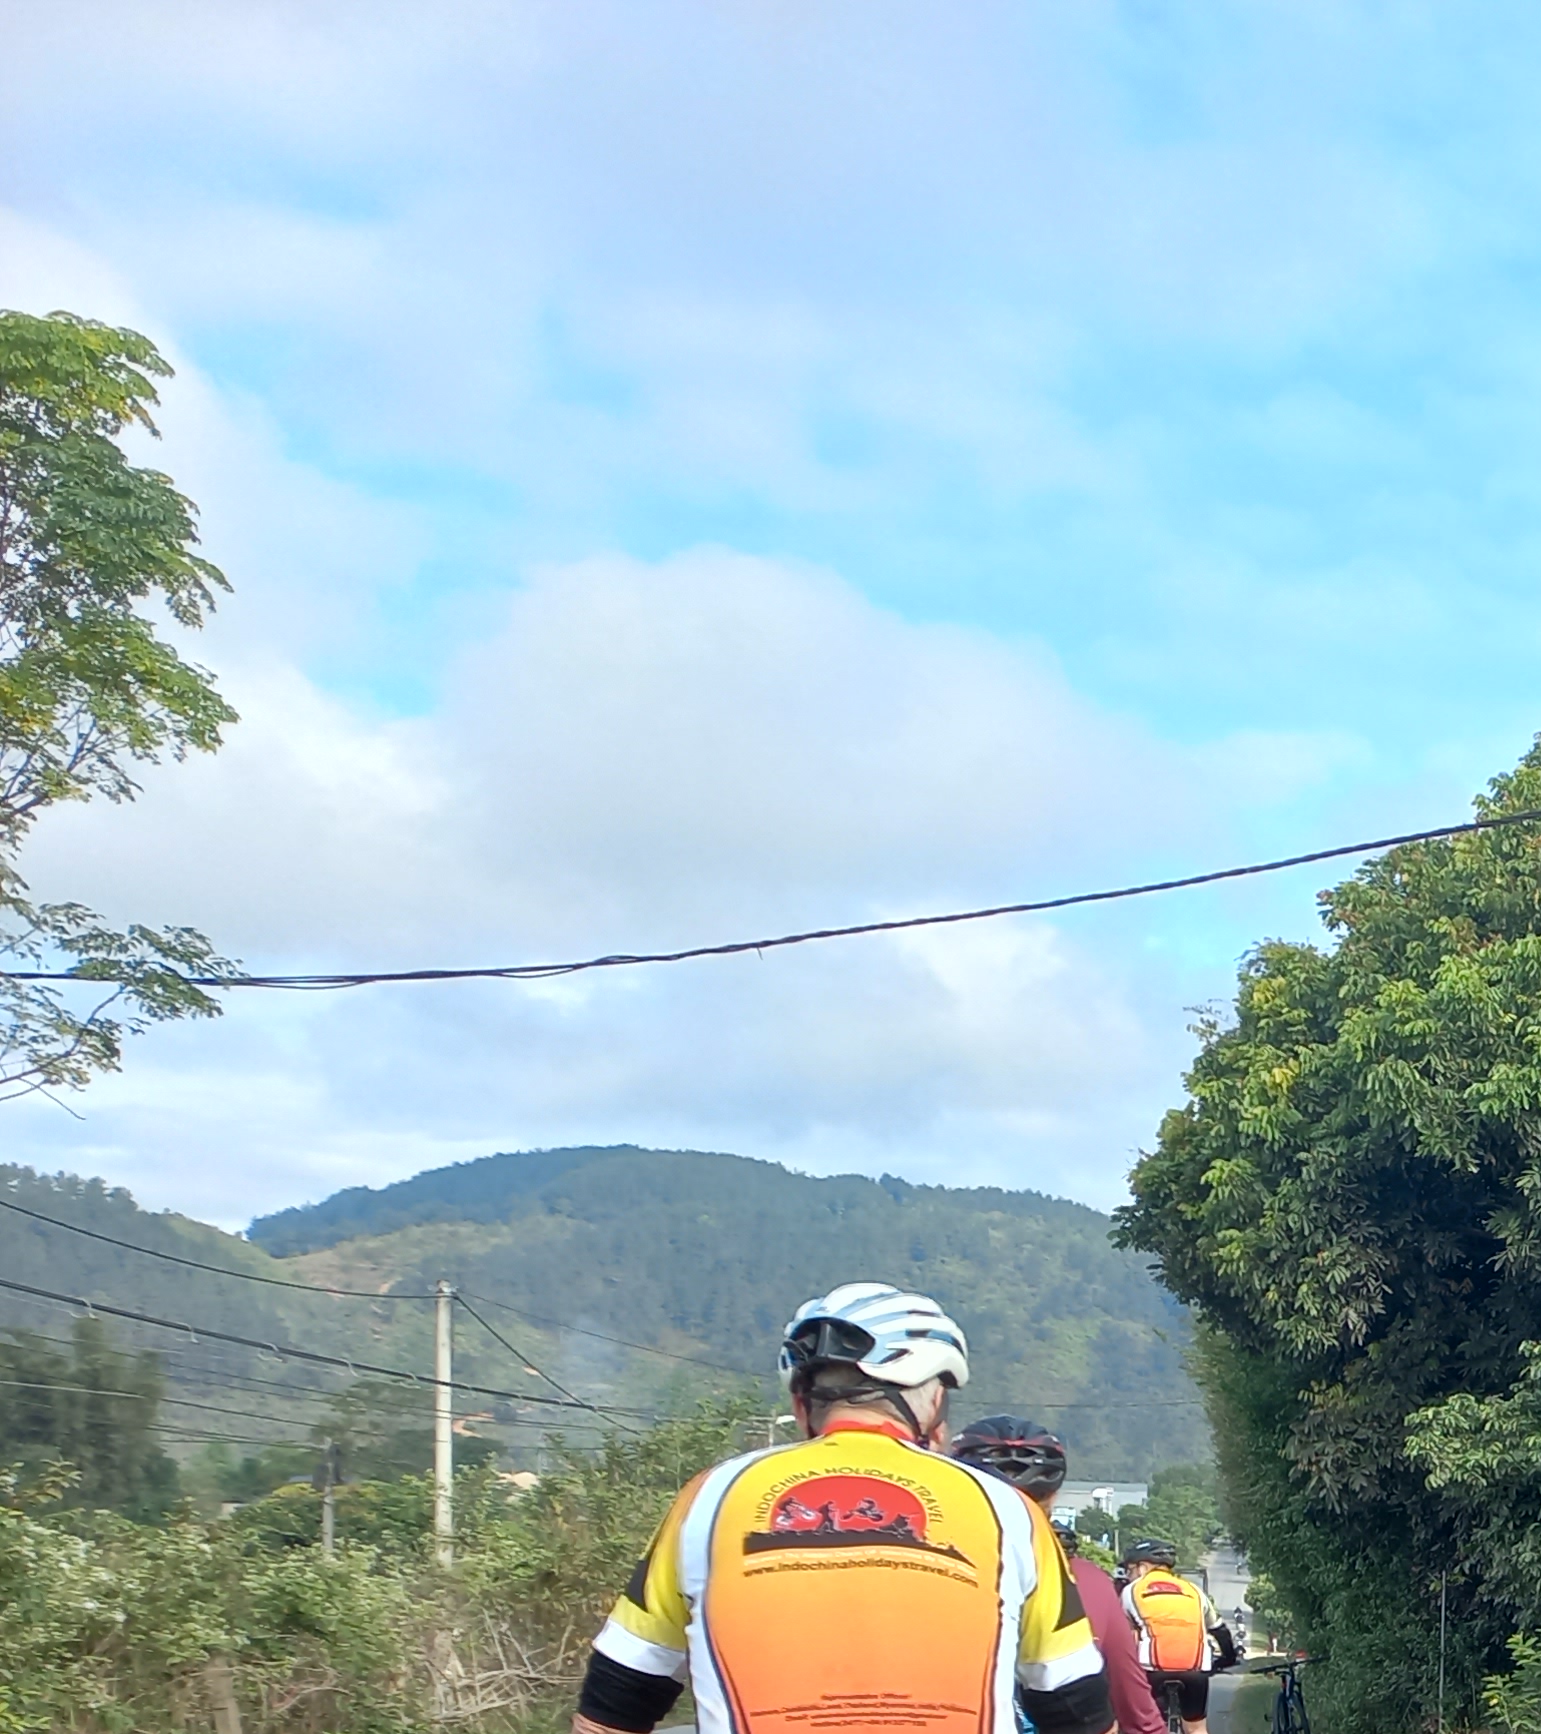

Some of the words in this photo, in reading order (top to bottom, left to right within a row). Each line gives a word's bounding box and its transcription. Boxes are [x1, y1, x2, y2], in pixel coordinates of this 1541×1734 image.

[754, 1470, 821, 1522] INDOCHINA
[824, 1466, 916, 1487] HOLIDAYS
[914, 1485, 944, 1523] TRAVEL
